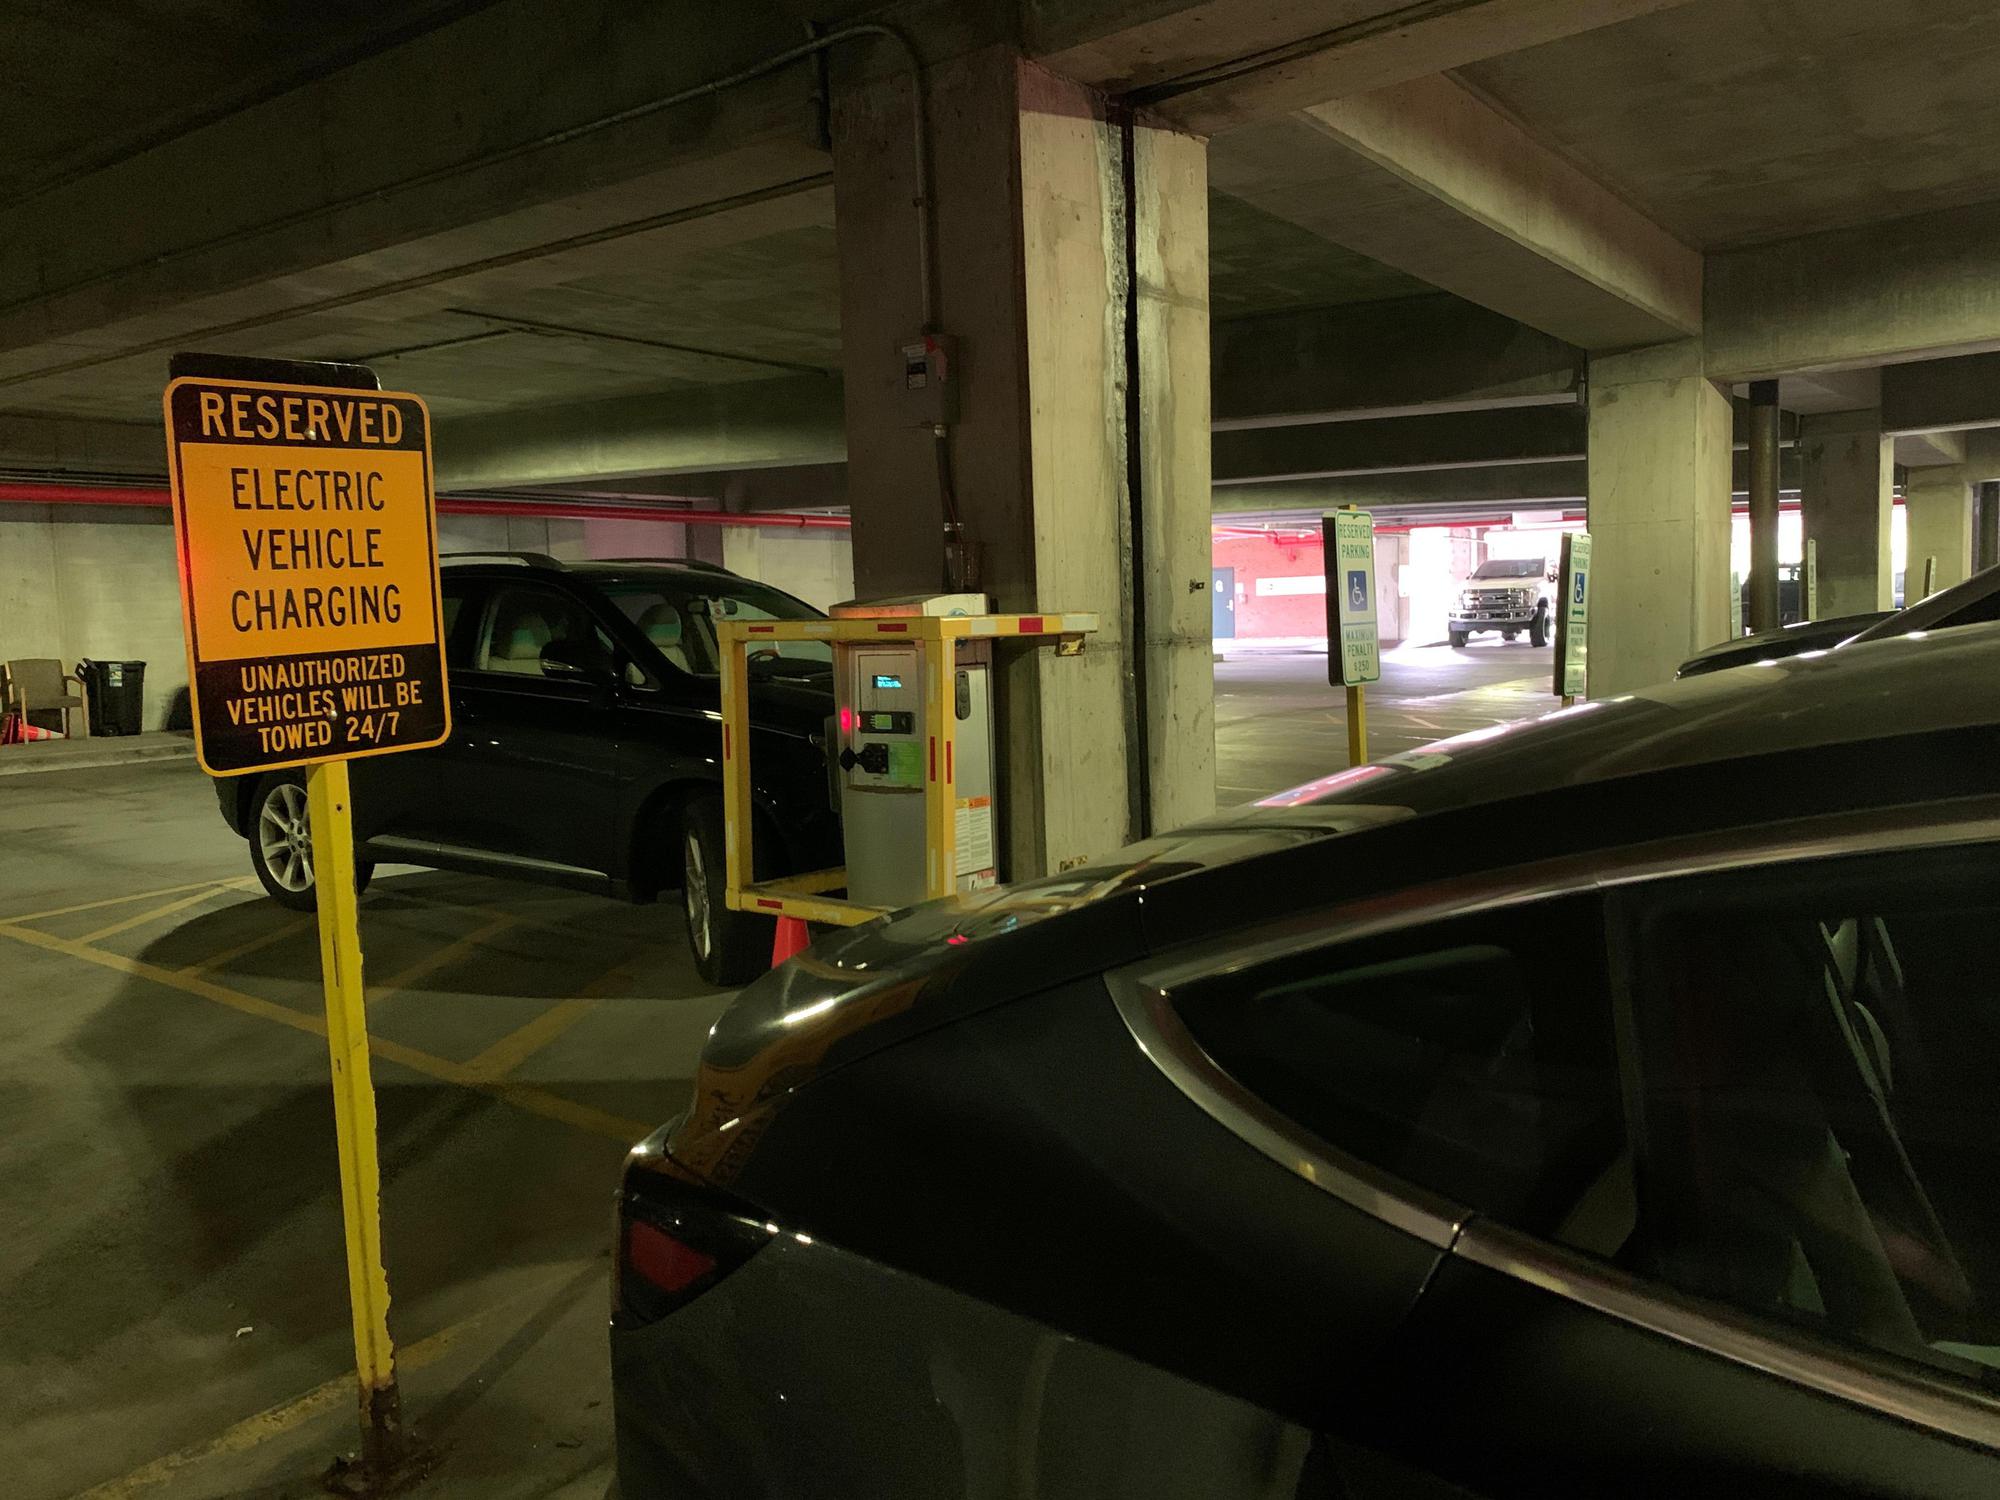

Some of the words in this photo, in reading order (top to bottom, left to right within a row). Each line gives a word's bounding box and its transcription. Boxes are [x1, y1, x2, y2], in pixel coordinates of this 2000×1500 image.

[200, 391, 403, 445] RESERVED
[231, 467, 385, 512] ELECTRIC
[242, 528, 384, 571] VEHICLE
[1339, 523, 1370, 540] RESERVED
[1341, 544, 1370, 559] PARKING
[231, 584, 401, 633] CHARGING
[1347, 644, 1374, 658] PENALTY
[241, 653, 405, 693] UNAUTHORIZED
[226, 689, 335, 726] VEHICLES
[341, 684, 394, 712] WILL
[396, 680, 423, 706] BE
[258, 721, 332, 754] TOWED
[346, 711, 400, 745] 24/7
